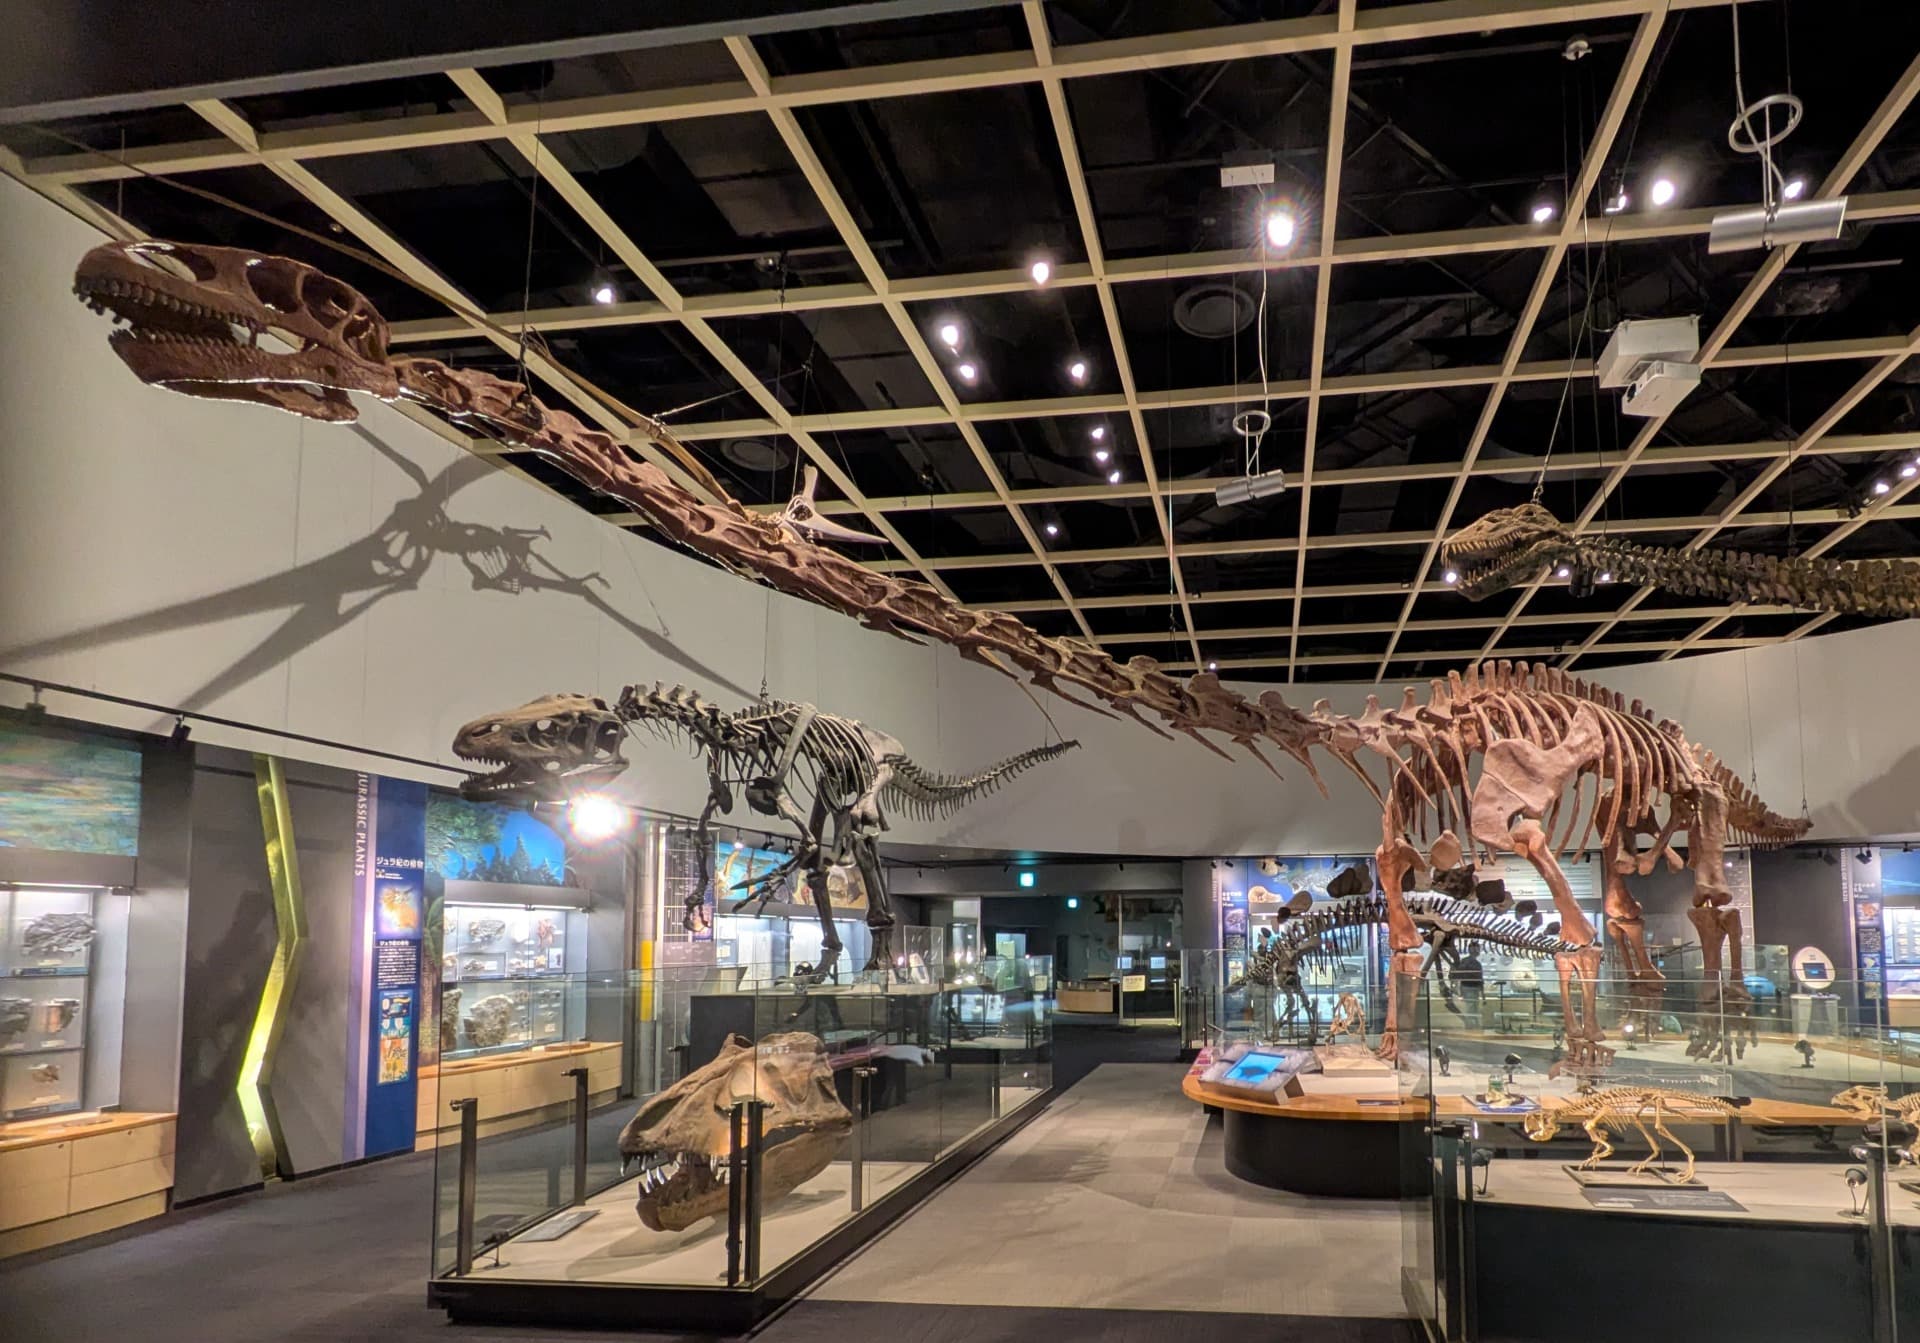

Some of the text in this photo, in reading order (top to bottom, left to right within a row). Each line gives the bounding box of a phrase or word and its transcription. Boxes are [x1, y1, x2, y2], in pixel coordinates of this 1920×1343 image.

[355, 773, 369, 876] JURASSIC PLANTS
[376, 856, 424, 869] ジュラ紀の植物
